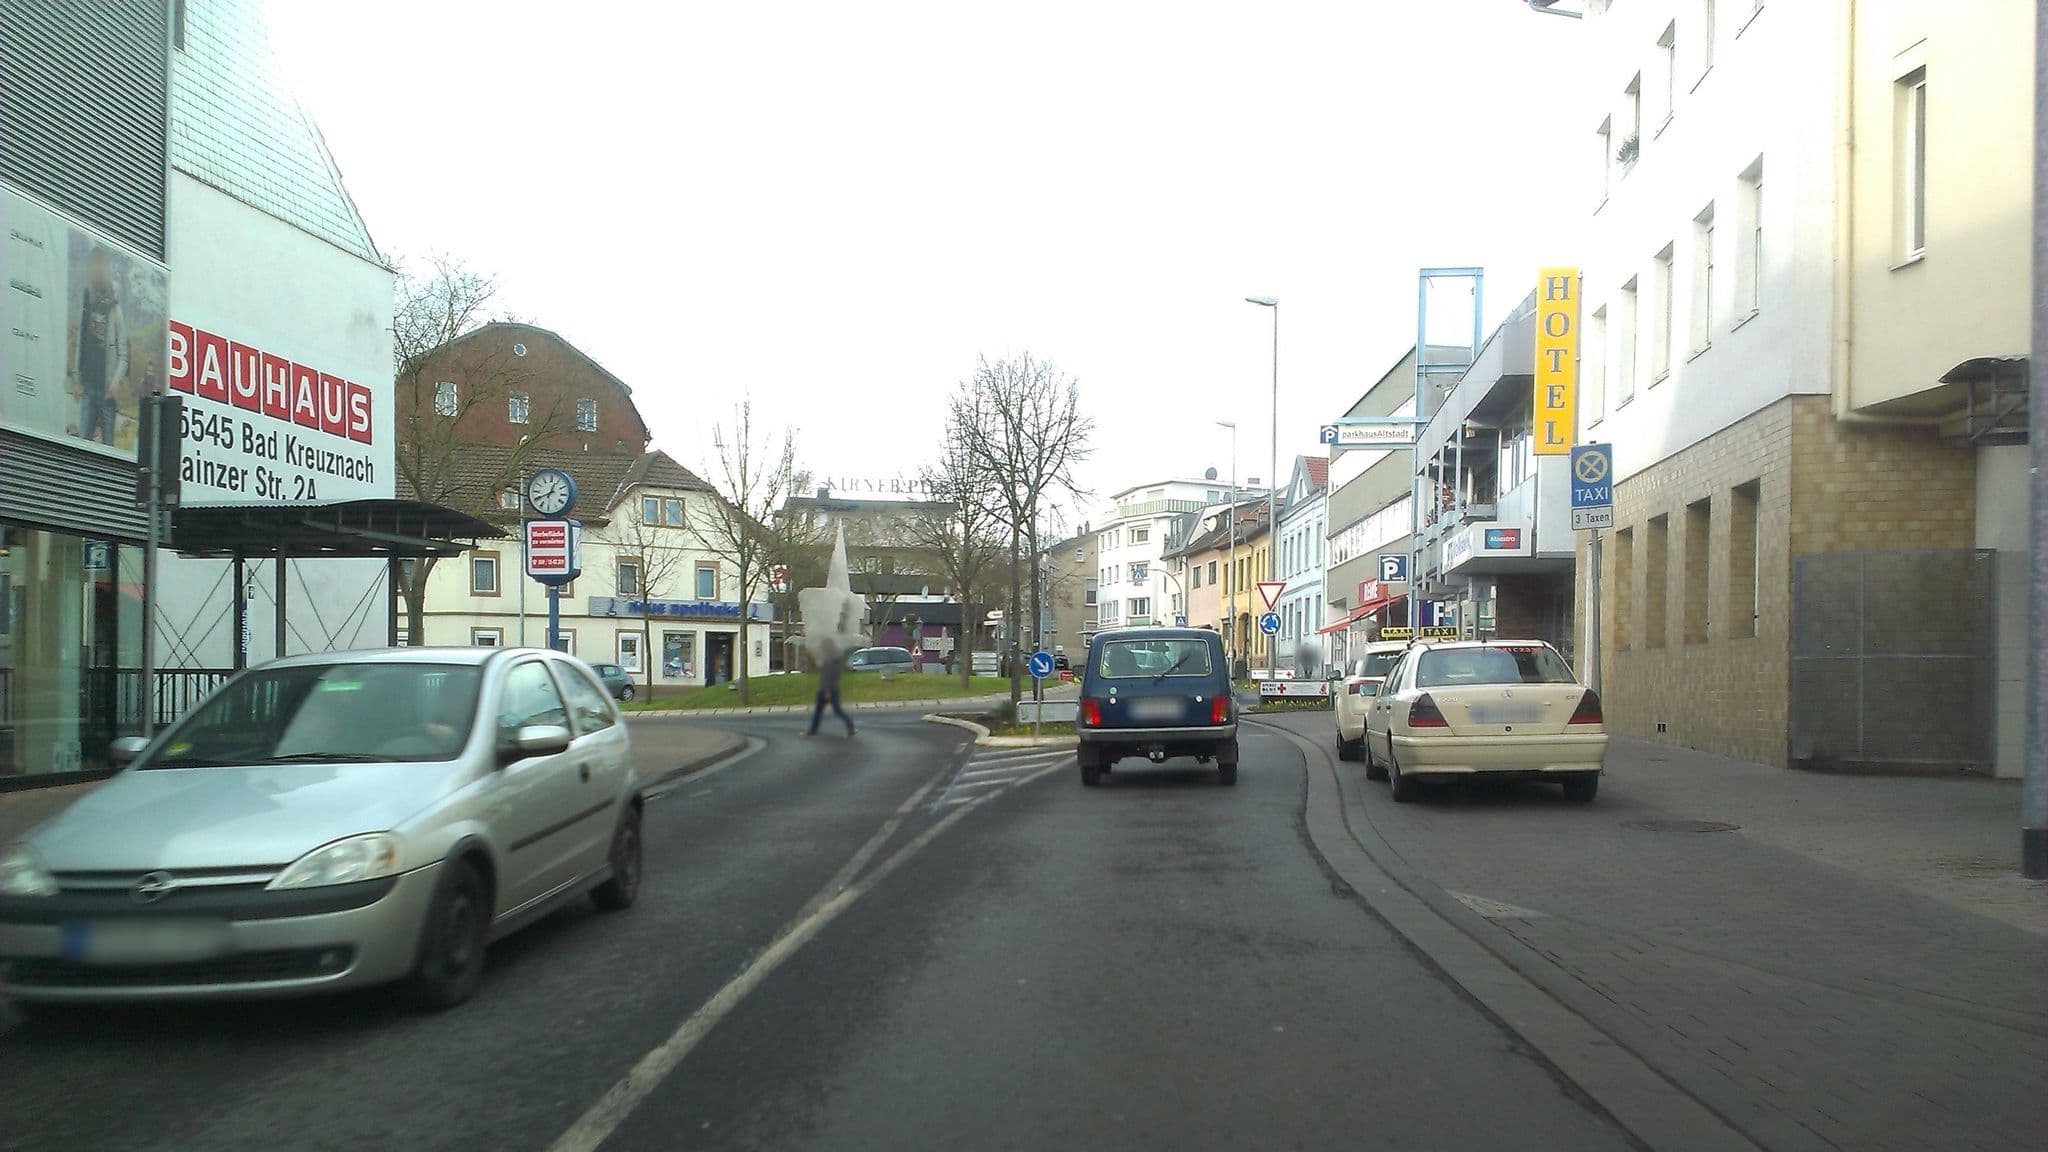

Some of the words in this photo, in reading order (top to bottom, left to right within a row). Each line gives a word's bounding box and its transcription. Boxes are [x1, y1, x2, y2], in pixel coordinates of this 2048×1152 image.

[1543, 275, 1570, 446] HOTEL
[169, 329, 369, 434] BAUHAUS
[179, 405, 234, 449] 5545
[242, 421, 278, 461] Bad
[285, 433, 374, 484] Kreuznach
[181, 450, 248, 493] ainzer
[254, 465, 287, 500] Str.
[293, 474, 317, 500] 2A
[1575, 486, 1609, 502] TAXI
[1575, 514, 1581, 524] 3
[1585, 513, 1610, 524] Taxen
[1383, 561, 1400, 581] P
[1426, 628, 1454, 636] TAXI
